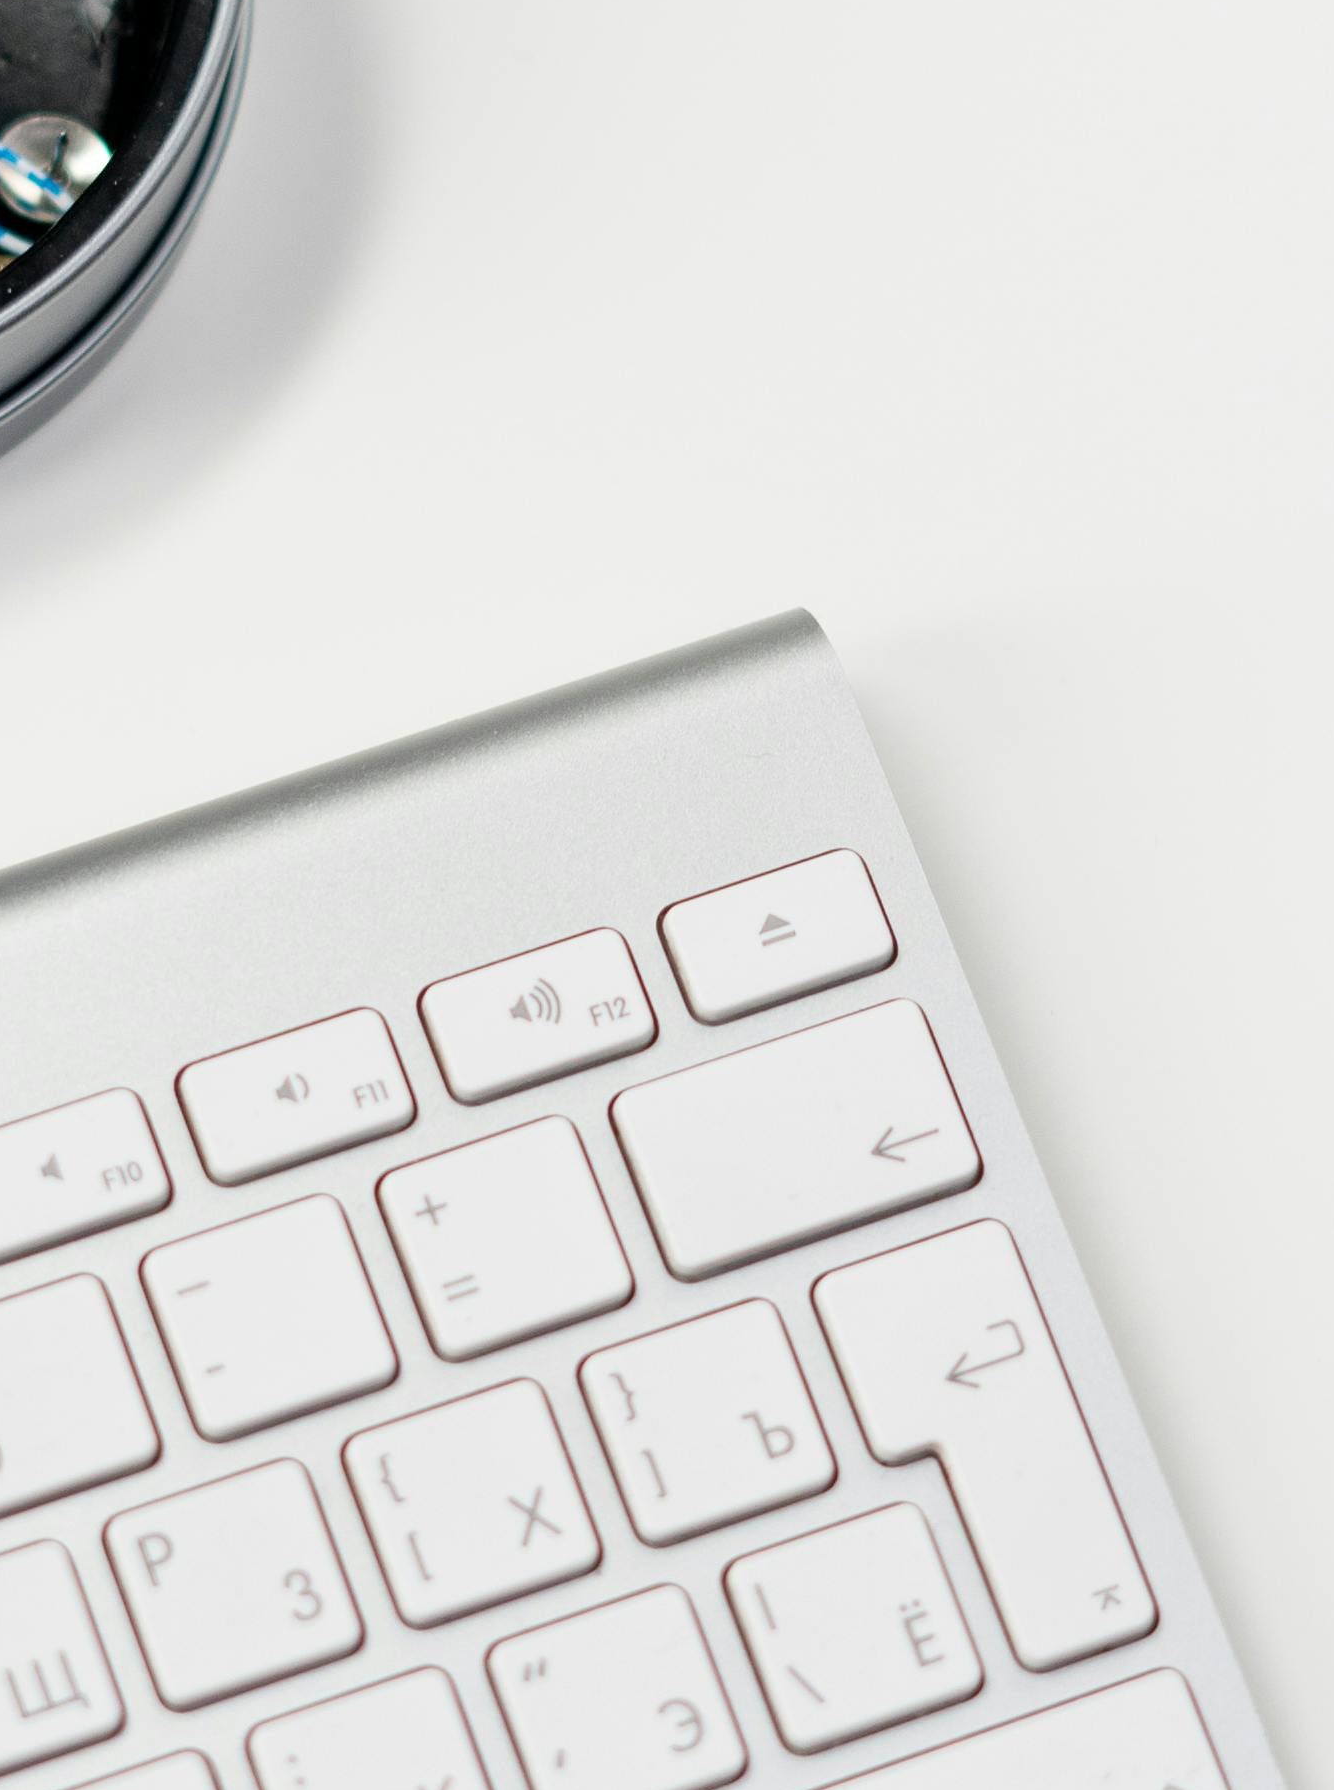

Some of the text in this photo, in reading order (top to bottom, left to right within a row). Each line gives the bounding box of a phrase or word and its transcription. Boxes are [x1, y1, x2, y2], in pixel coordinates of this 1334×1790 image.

[588, 996, 630, 1027] F12
[351, 1079, 389, 1109] F11
[100, 1160, 144, 1191] F10
[741, 1410, 796, 1461] Ъ
[136, 1532, 174, 1588] P
[282, 1567, 324, 1623] З
[899, 1600, 945, 1668] Ё
[4, 1651, 89, 1721] Щ
[656, 1697, 706, 1754] Э
